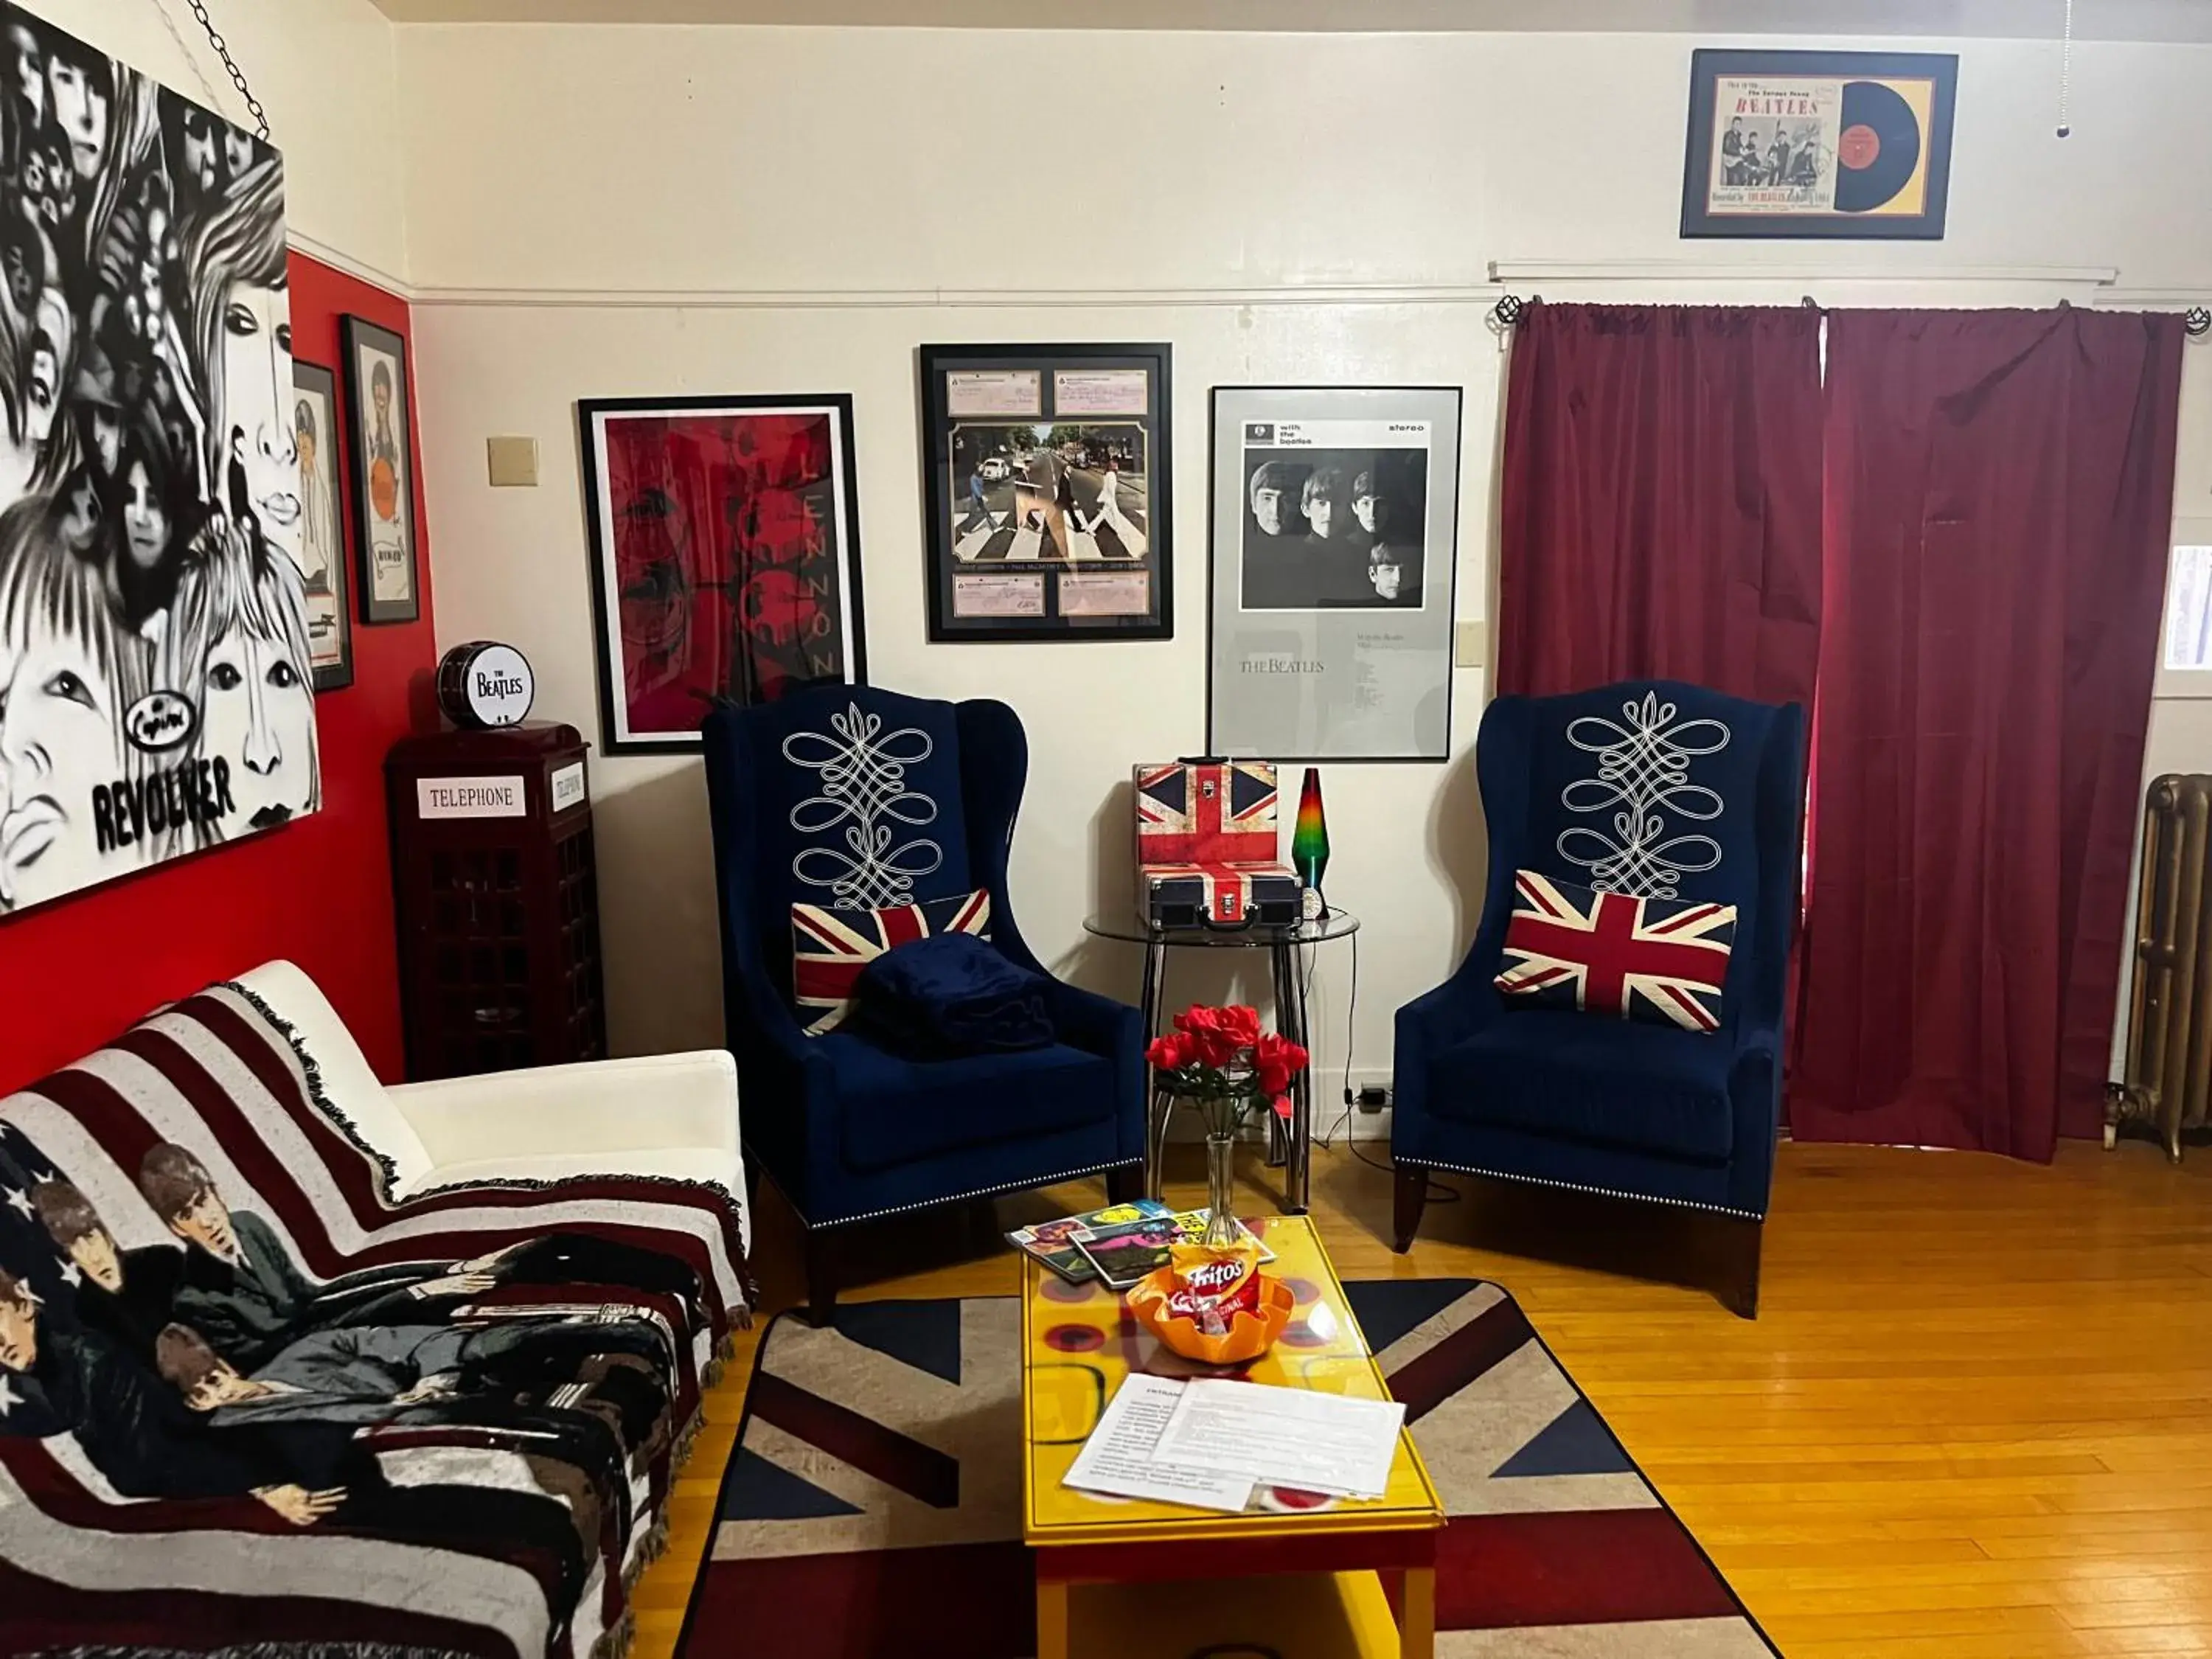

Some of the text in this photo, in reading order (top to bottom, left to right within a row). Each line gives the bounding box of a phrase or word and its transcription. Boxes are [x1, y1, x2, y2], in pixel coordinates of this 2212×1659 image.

[1736, 97, 1818, 114] BEATLES
[476, 672, 523, 700] BEATLES
[92, 755, 236, 854] REVOLVER
[429, 787, 513, 807] TELEPHONE
[1188, 1262, 1242, 1288] Fritos
